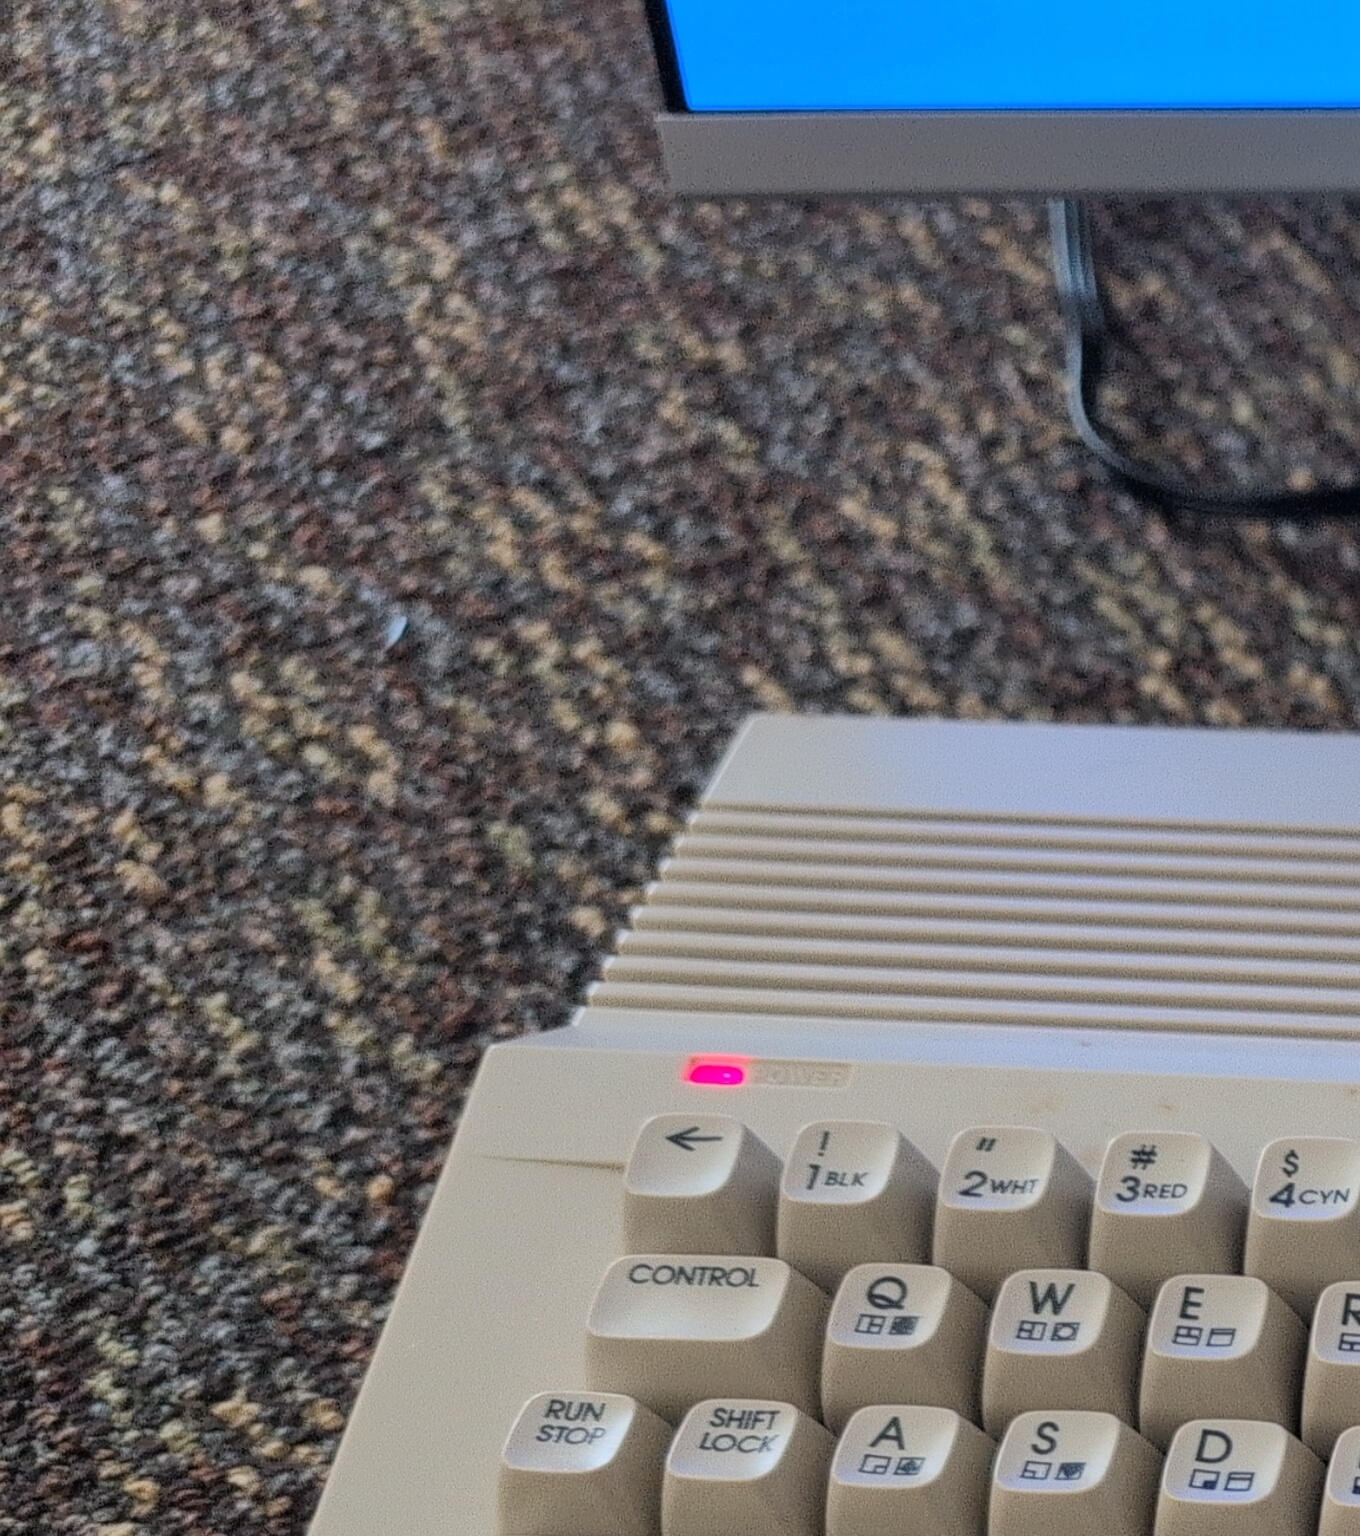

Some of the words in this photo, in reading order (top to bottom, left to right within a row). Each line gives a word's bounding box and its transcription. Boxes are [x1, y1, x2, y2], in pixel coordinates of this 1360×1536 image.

[1130, 1146, 1157, 1169] #
[1282, 1149, 1299, 1178] $
[806, 1163, 821, 1190] 1
[823, 1170, 866, 1187] BLK
[958, 1170, 988, 1198] 2
[988, 1176, 1040, 1196] WHT
[1115, 1175, 1141, 1203] 3
[1142, 1183, 1188, 1199] RED
[1268, 1182, 1295, 1208] 4
[1297, 1188, 1349, 1206] CYN
[628, 1263, 758, 1288] CONTROL
[866, 1276, 908, 1310] Q
[1029, 1281, 1075, 1316] W
[1178, 1286, 1204, 1321] E
[543, 1398, 605, 1422] RUN
[708, 1407, 780, 1430] SHIFT
[535, 1424, 607, 1446] STOP
[699, 1431, 778, 1453] LOCK
[869, 1416, 905, 1450] A
[1031, 1421, 1059, 1456] S
[1194, 1428, 1233, 1464] D
